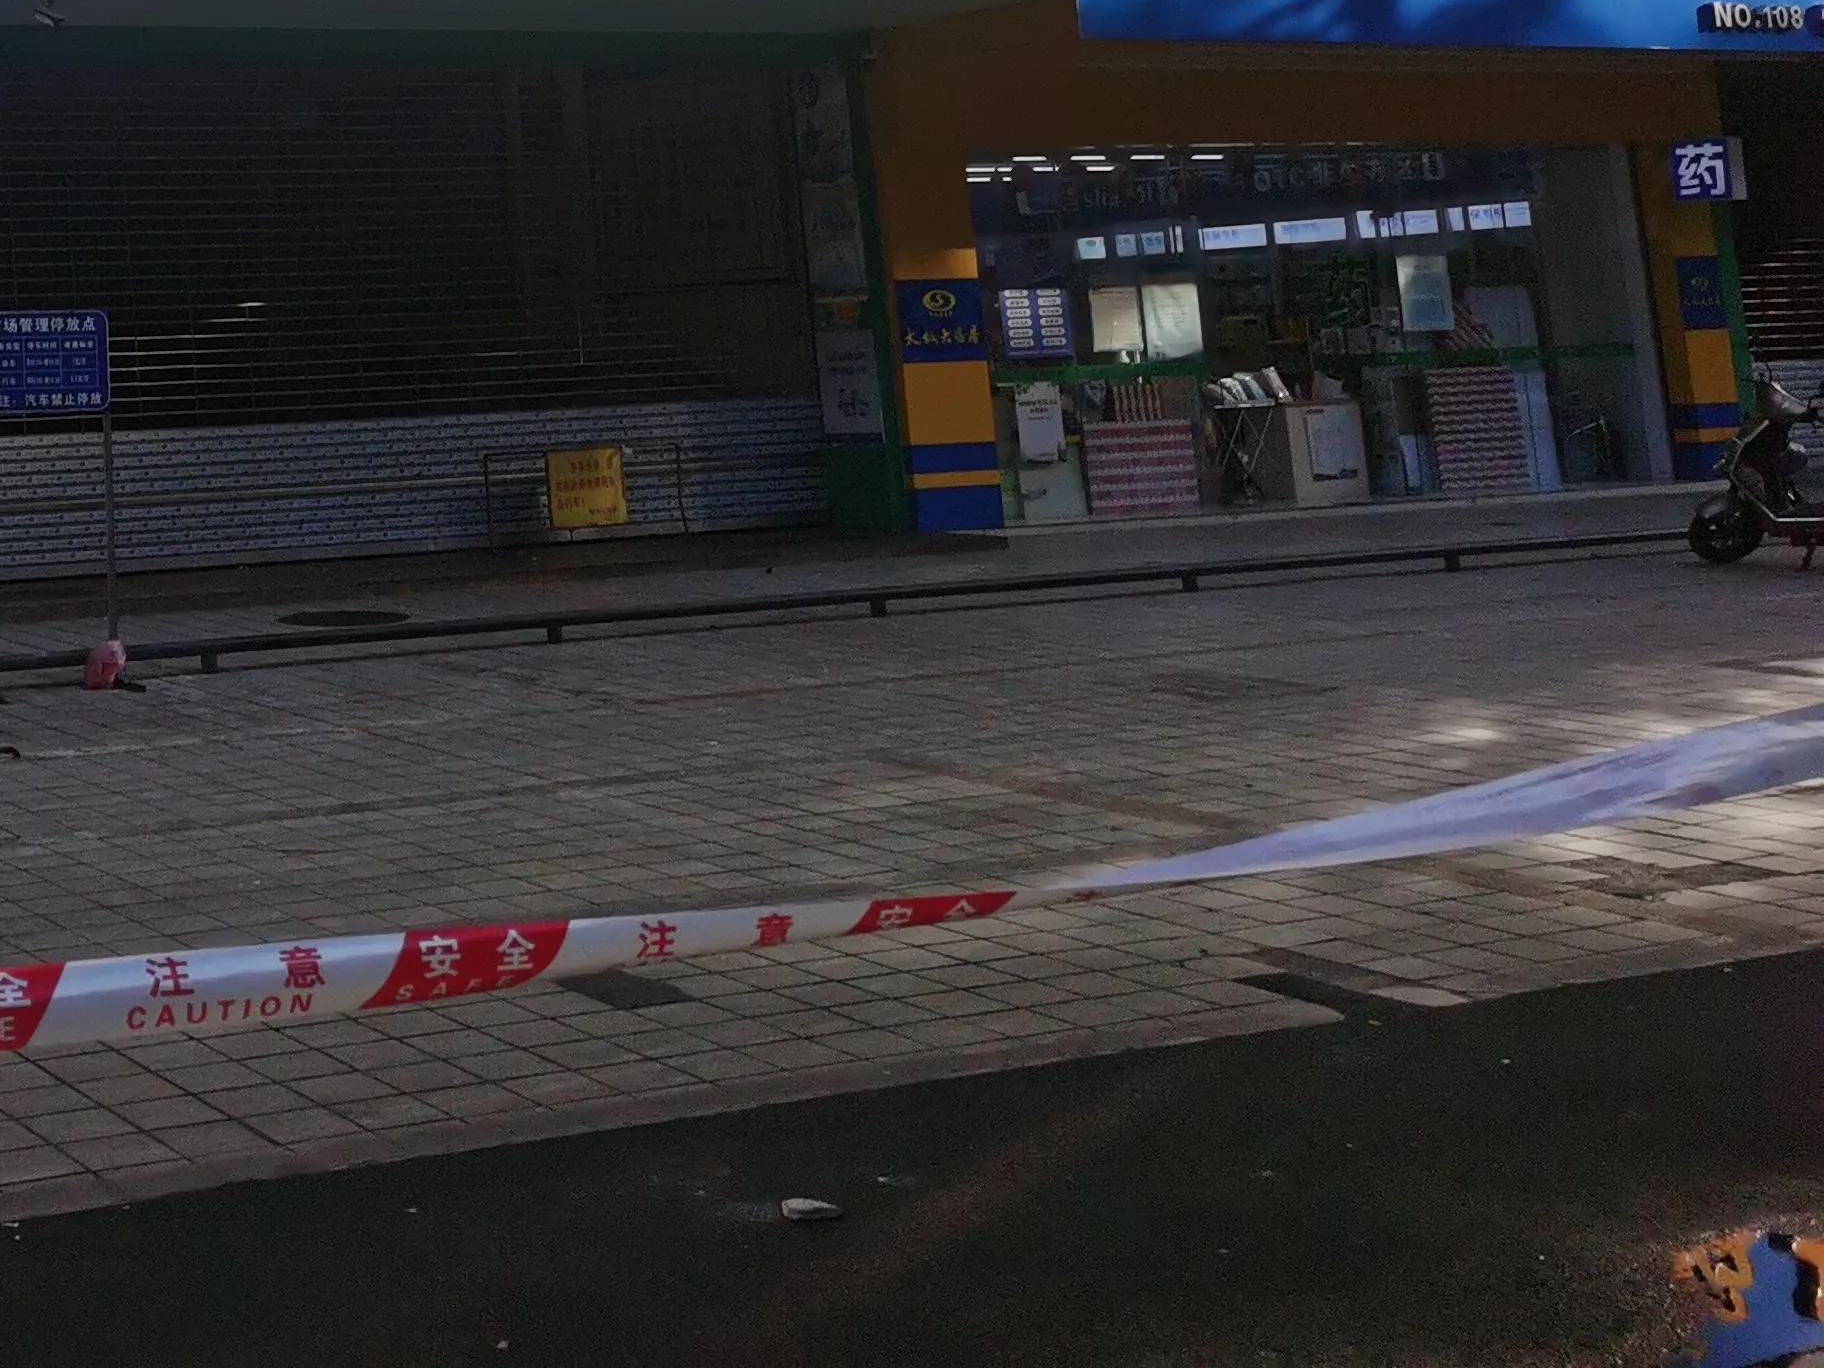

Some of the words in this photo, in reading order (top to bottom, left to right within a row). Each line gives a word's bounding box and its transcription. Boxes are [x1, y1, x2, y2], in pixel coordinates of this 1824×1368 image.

[1675, 143, 1726, 197] 药
[143, 945, 325, 998] 注意
[419, 930, 534, 979] 安全
[126, 994, 313, 1030] CAUTION
